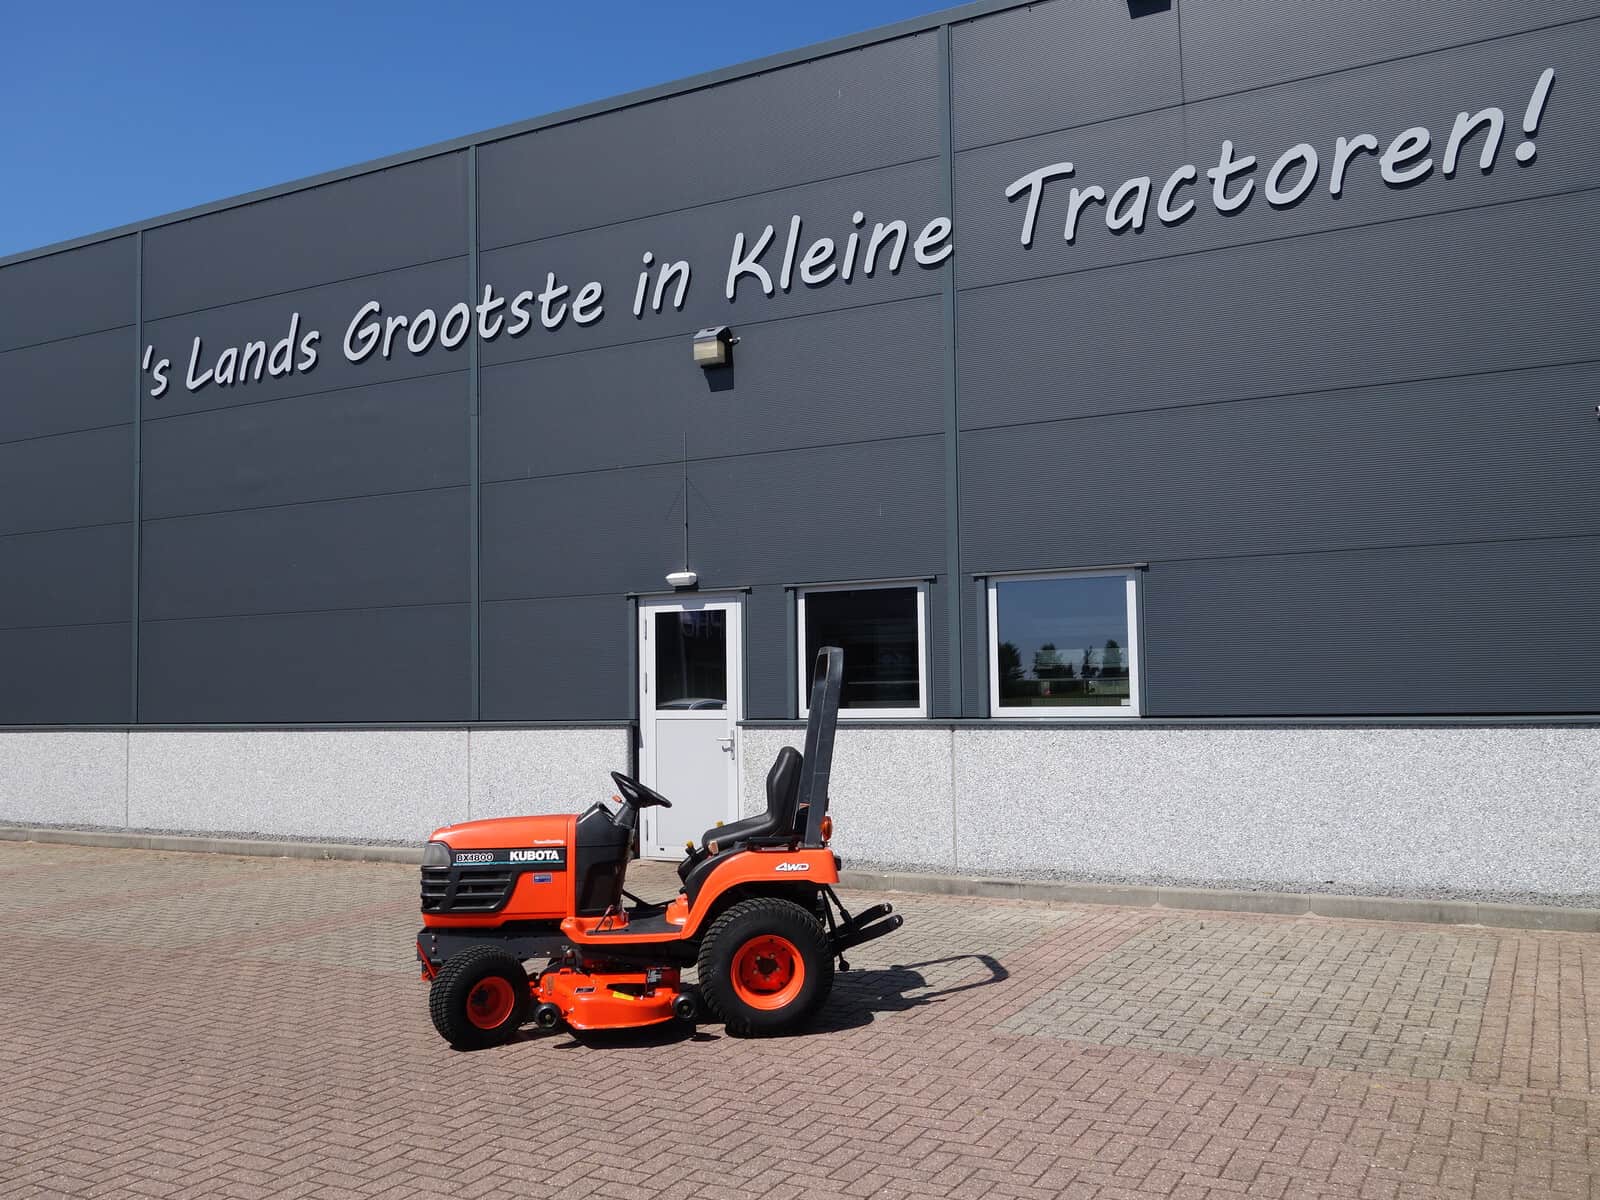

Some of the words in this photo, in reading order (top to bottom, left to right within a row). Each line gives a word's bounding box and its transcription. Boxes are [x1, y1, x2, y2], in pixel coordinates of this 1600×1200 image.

[142, 344, 170, 397] 's
[186, 313, 320, 390] Lands
[344, 273, 603, 361] Grootste
[633, 252, 690, 315] in
[725, 211, 953, 299] Kleine
[1005, 68, 1554, 245] Tractoren!
[509, 850, 559, 861] KUBOTA
[775, 862, 810, 872] 4WD
